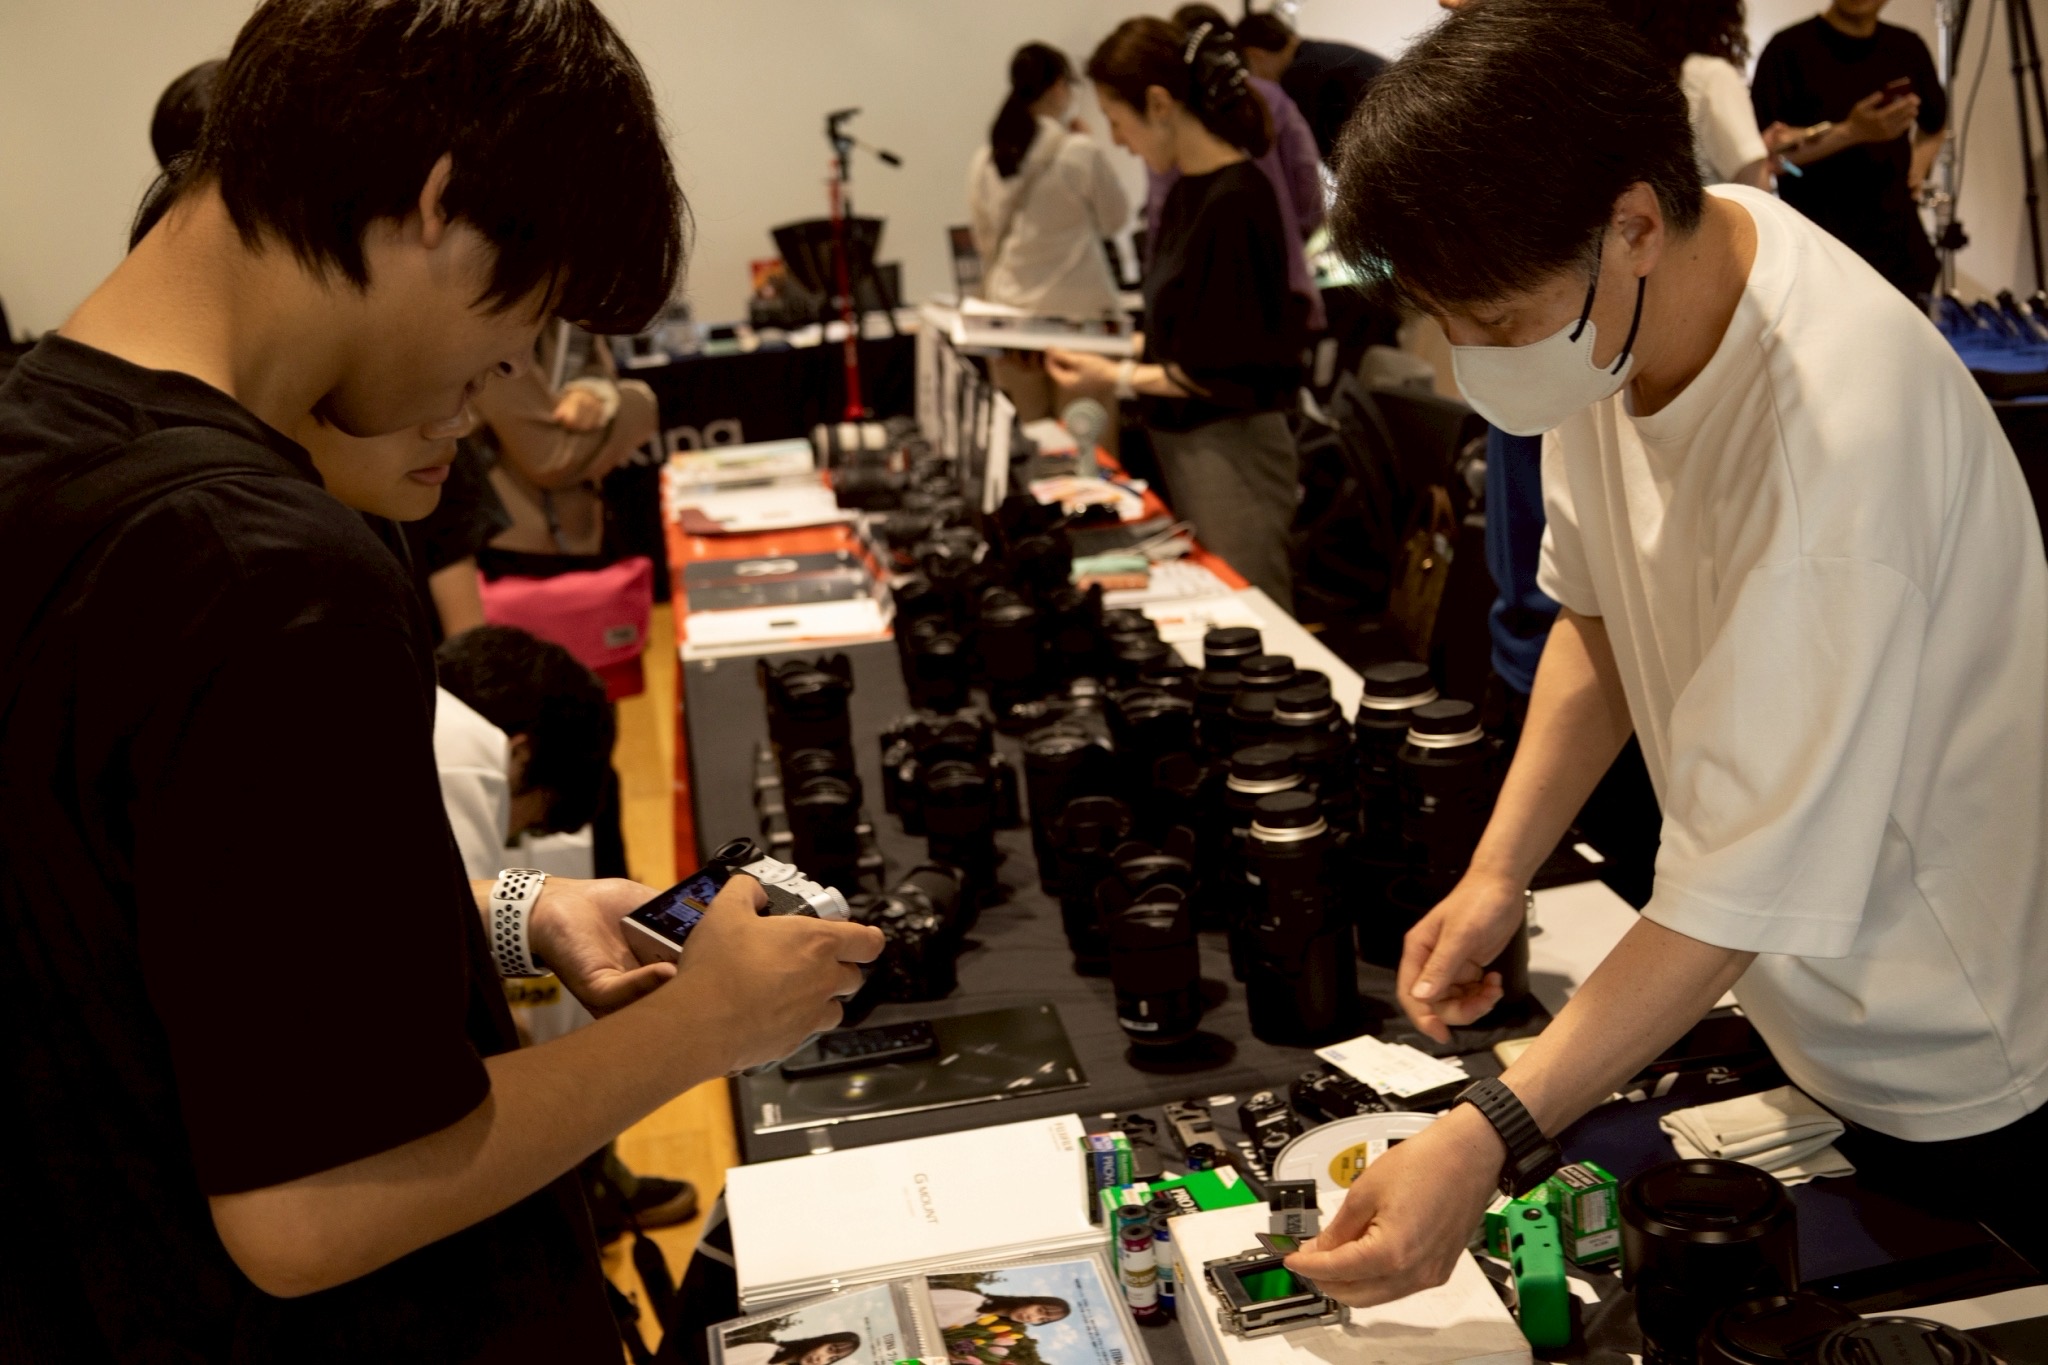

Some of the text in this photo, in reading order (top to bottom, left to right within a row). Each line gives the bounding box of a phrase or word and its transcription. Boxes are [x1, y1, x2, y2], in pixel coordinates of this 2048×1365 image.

[914, 1172, 938, 1225] G MOUNT
[1171, 1188, 1195, 1206] PRO
